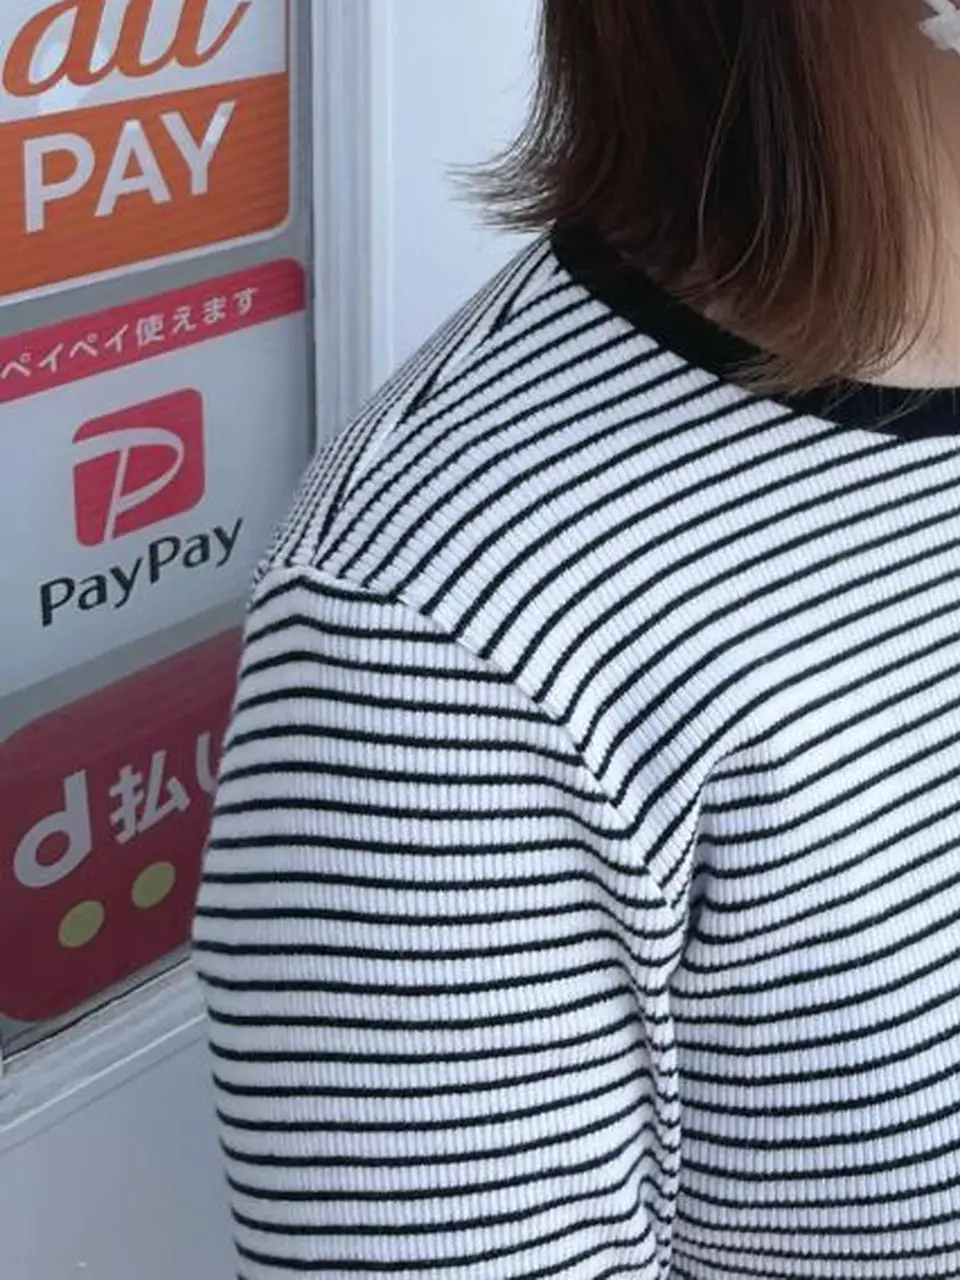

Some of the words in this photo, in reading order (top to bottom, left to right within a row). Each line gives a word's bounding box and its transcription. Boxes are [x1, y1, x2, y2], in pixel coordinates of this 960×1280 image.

[23, 100, 237, 234] PAY
[0, 288, 259, 380] ペイペイ使えます
[40, 518, 243, 626] PayPay
